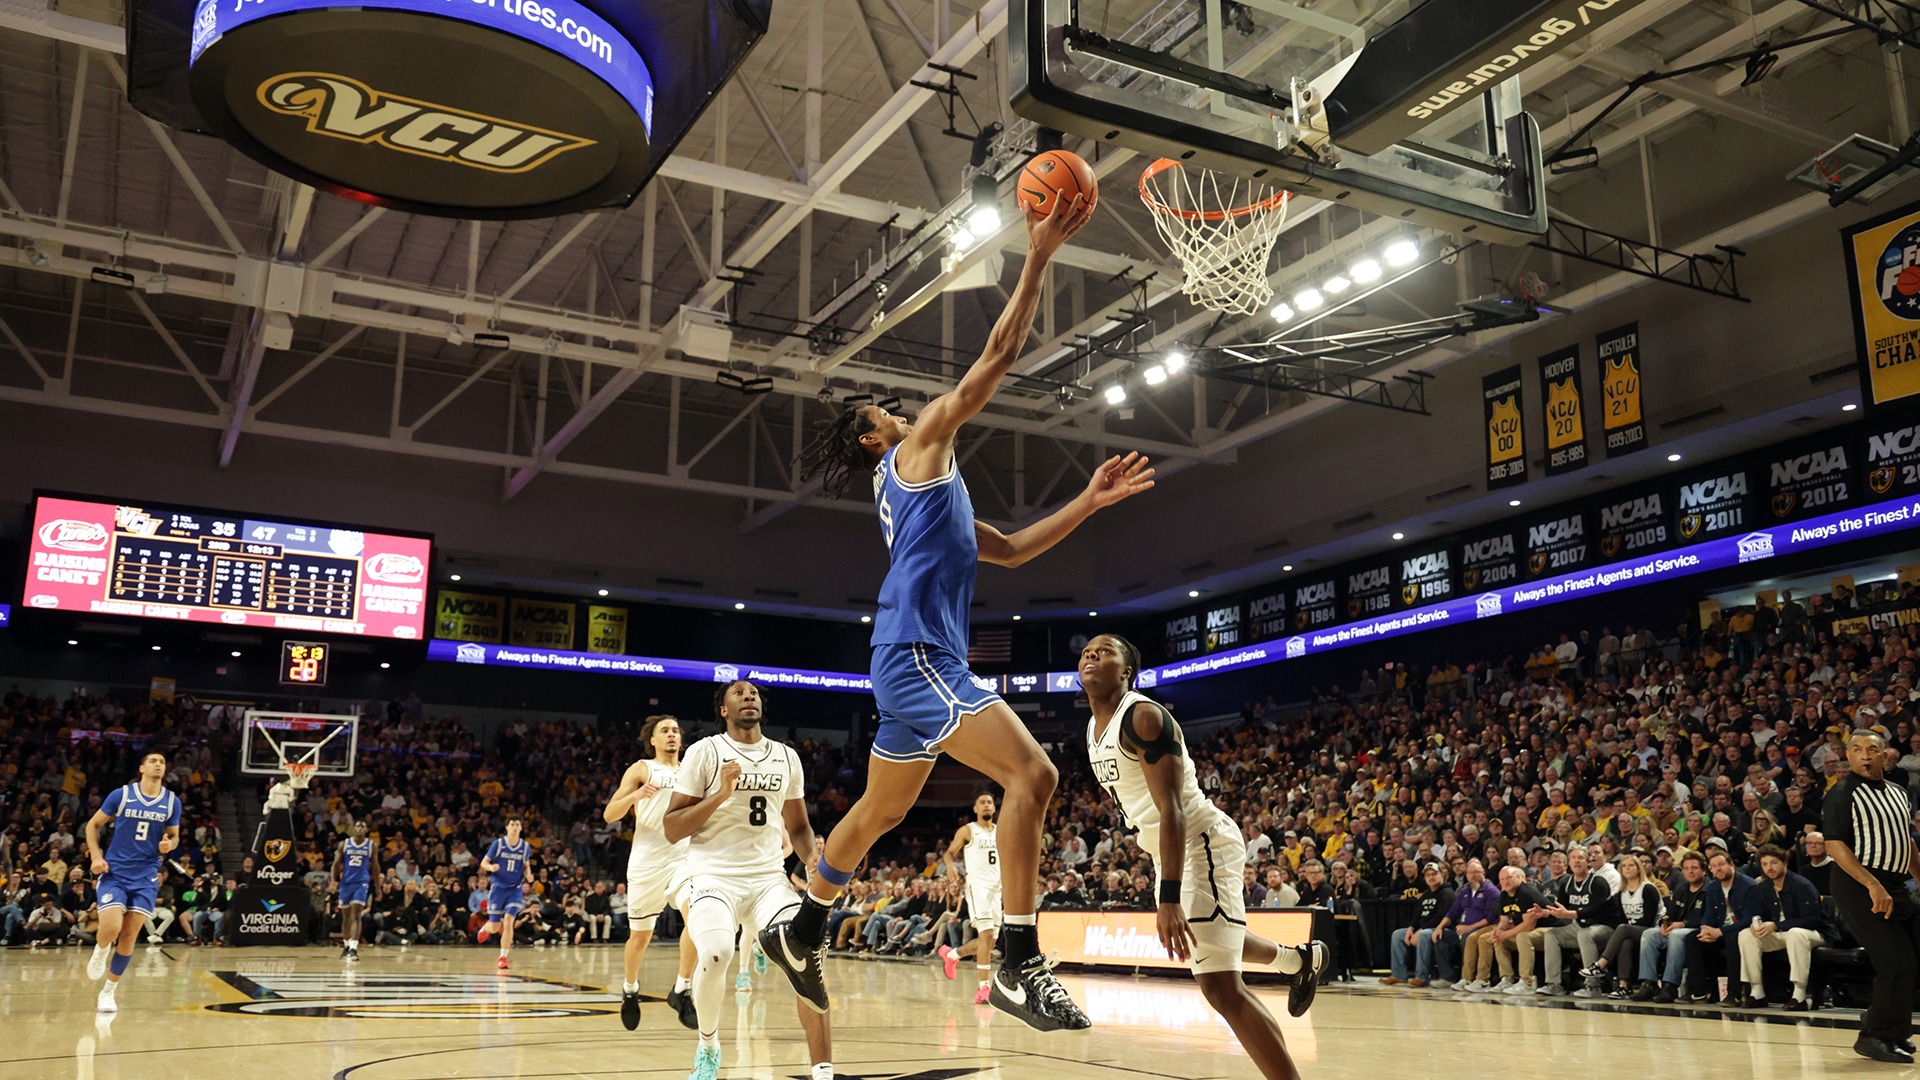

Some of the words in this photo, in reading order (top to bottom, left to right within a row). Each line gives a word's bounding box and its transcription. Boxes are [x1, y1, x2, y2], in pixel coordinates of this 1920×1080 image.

[272, 78, 565, 167] VCU
[1544, 357, 1575, 379] HOOVER
[1606, 378, 1636, 399] VCU
[1549, 400, 1577, 420] VCU
[1612, 398, 1628, 416] 21
[1492, 418, 1518, 437] VCU
[1556, 418, 1572, 437] 20
[1498, 434, 1514, 452] 00
[1770, 446, 1847, 487] NCAA
[1680, 472, 1747, 509] NCAA
[1802, 482, 1848, 508] 2012
[116, 506, 163, 536] VCU
[1601, 493, 1663, 530] NCAA
[1706, 508, 1742, 532] 2011
[212, 522, 236, 536] 35
[252, 526, 276, 541] 47
[1528, 514, 1583, 548] NCAA
[1791, 524, 1838, 543] Always
[1839, 518, 1862, 532] the
[1864, 506, 1910, 527] Finest
[1625, 525, 1666, 550] 2009
[246, 545, 274, 555] 12:13
[1464, 535, 1514, 564] NCAA
[1550, 545, 1586, 568] 2007
[34, 552, 106, 572] RAISING
[1403, 551, 1449, 580] NCAA
[38, 567, 101, 585] CANE'S
[1349, 566, 1390, 594] NCAA
[1483, 564, 1516, 584] 2004
[1513, 587, 1546, 603] Always
[1547, 582, 1563, 596] the
[1564, 576, 1595, 592] Finest
[1596, 569, 1632, 586] Agents
[1634, 562, 1654, 577] and
[1655, 555, 1700, 572] Service.
[1296, 581, 1336, 606] NCAA
[1421, 578, 1450, 598] 1996
[442, 598, 498, 618] NCAA
[1250, 594, 1286, 617] NCAA
[1365, 594, 1390, 611] 1985
[515, 606, 568, 624] NCAA
[1207, 606, 1240, 628] NCAA
[1311, 607, 1336, 624] 1984
[1166, 616, 1197, 637] NCAA
[1313, 636, 1338, 646] Always
[1338, 630, 1350, 640] the
[1351, 625, 1373, 638] Finest
[1374, 621, 1401, 634] Agents
[1402, 616, 1416, 627] and
[1417, 610, 1449, 623] Service.
[535, 632, 568, 644] 2021
[1219, 630, 1238, 645] 1981
[292, 646, 324, 660] 12:13
[497, 650, 532, 663] Always
[532, 652, 548, 663] the
[549, 654, 578, 666] Finest
[578, 656, 610, 668] Agents
[612, 660, 628, 670] and
[630, 660, 664, 672] Service.
[1162, 669, 1181, 678] Always
[1182, 666, 1191, 674] the
[1192, 662, 1209, 672] Finest
[1210, 658, 1230, 670] Agents
[1230, 656, 1242, 664] and
[1242, 650, 1266, 662] Service.
[749, 671, 778, 682] Always
[779, 672, 793, 682] the
[794, 674, 818, 684] Finest
[820, 676, 848, 687] Agents
[848, 678, 863, 688] and
[1056, 676, 1073, 688] 47
[125, 808, 166, 822] BILLIKENS
[749, 796, 767, 826] 8
[135, 822, 150, 840] 9
[348, 855, 362, 866] 25
[507, 860, 515, 872] 11
[988, 850, 996, 865] 6
[257, 865, 294, 884] Kroger
[239, 924, 270, 933] Credit
[270, 924, 299, 933] Union
[241, 914, 299, 924] VIRGINIA
